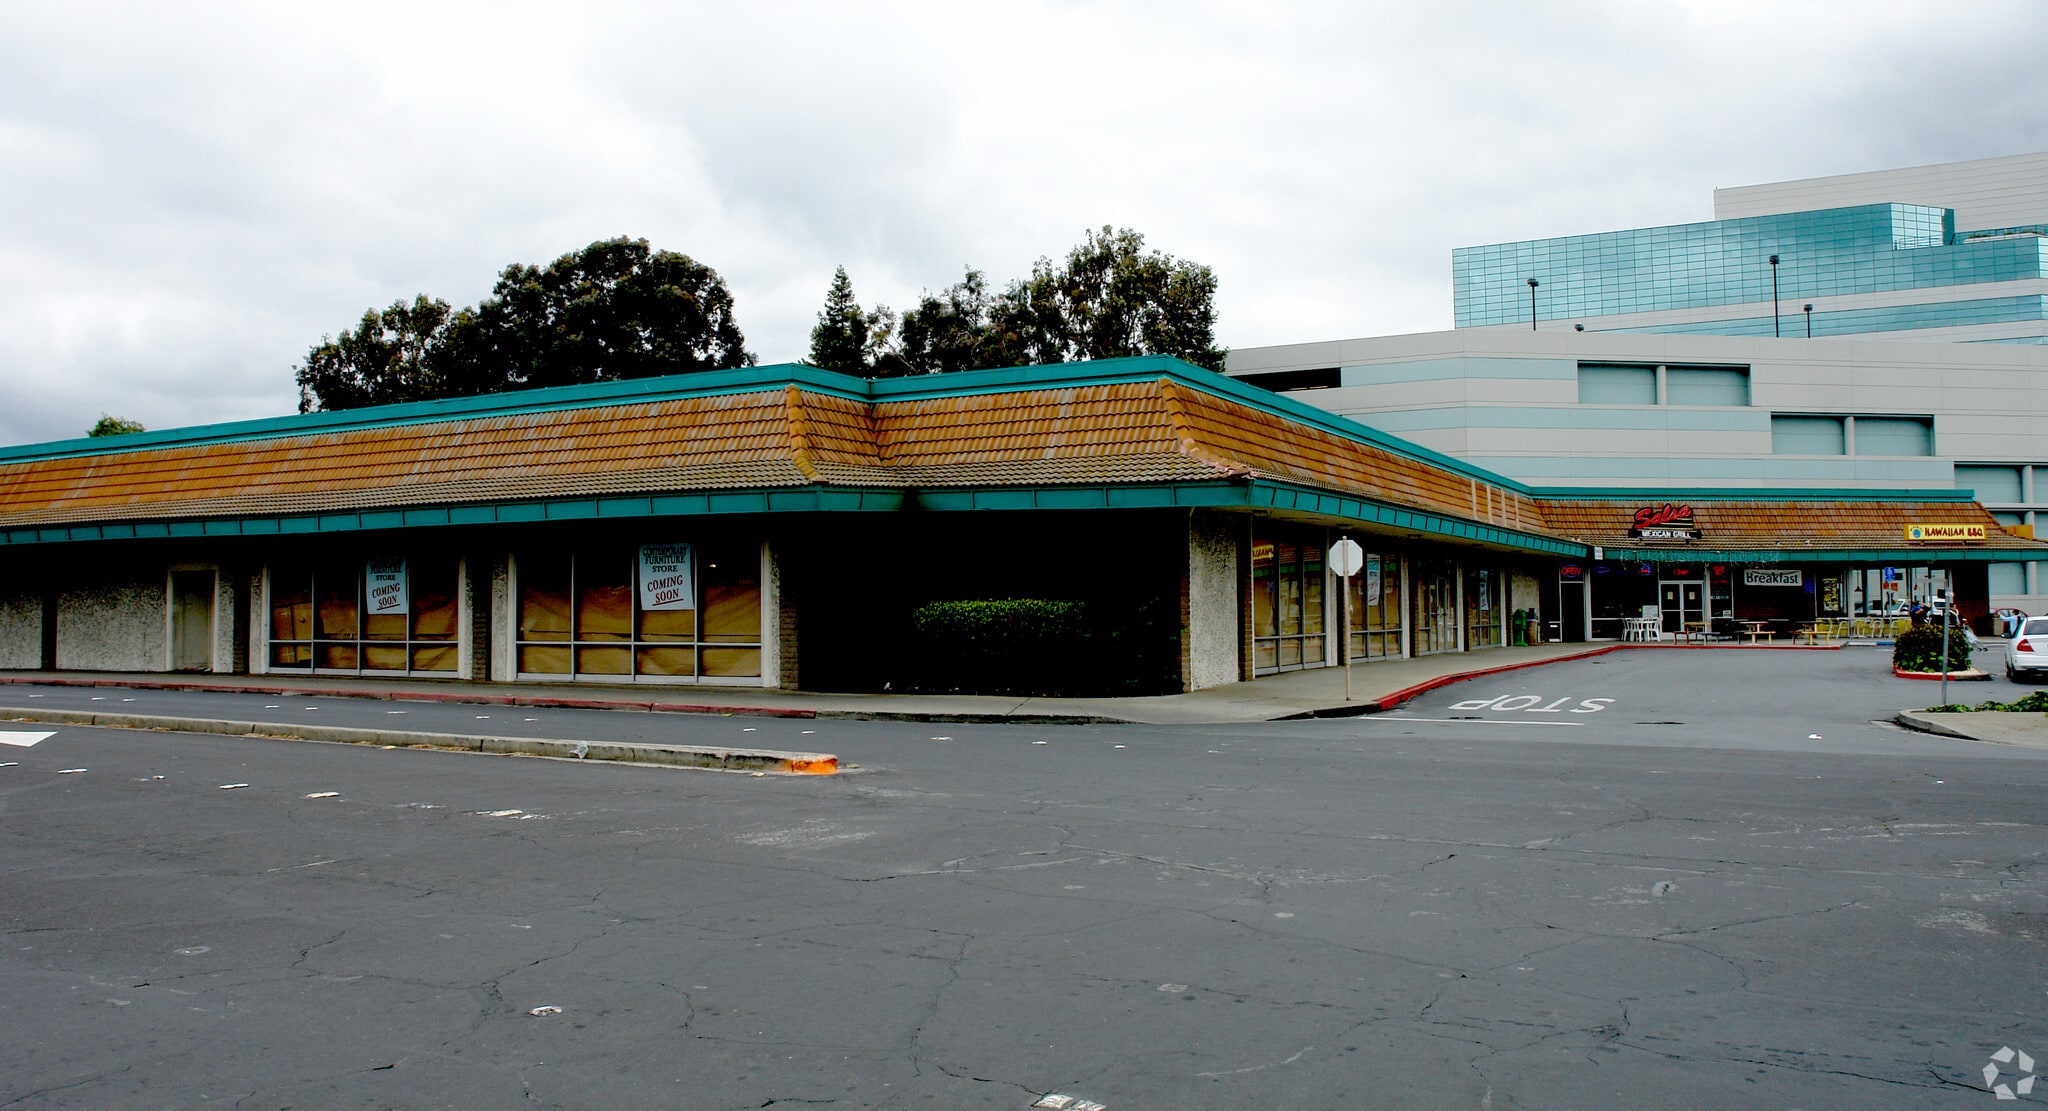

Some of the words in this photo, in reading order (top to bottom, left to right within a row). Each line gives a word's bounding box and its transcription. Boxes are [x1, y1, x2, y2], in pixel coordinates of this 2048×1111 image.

[1634, 504, 1691, 528] Salsa
[1642, 530, 1671, 538] MEXICAN
[1673, 530, 1691, 538] GRILL
[1924, 526, 1965, 537] HAWAIIAN
[1967, 528, 1984, 537] BBQ
[645, 556, 685, 564] FURNITURE
[1560, 566, 1582, 576] OPEN
[1746, 571, 1800, 585] Breakfast
[372, 582, 401, 598] COMING
[647, 575, 683, 592] COMING
[378, 595, 397, 608] SOON
[655, 588, 679, 602] SOON
[1448, 694, 1616, 713] STOP
